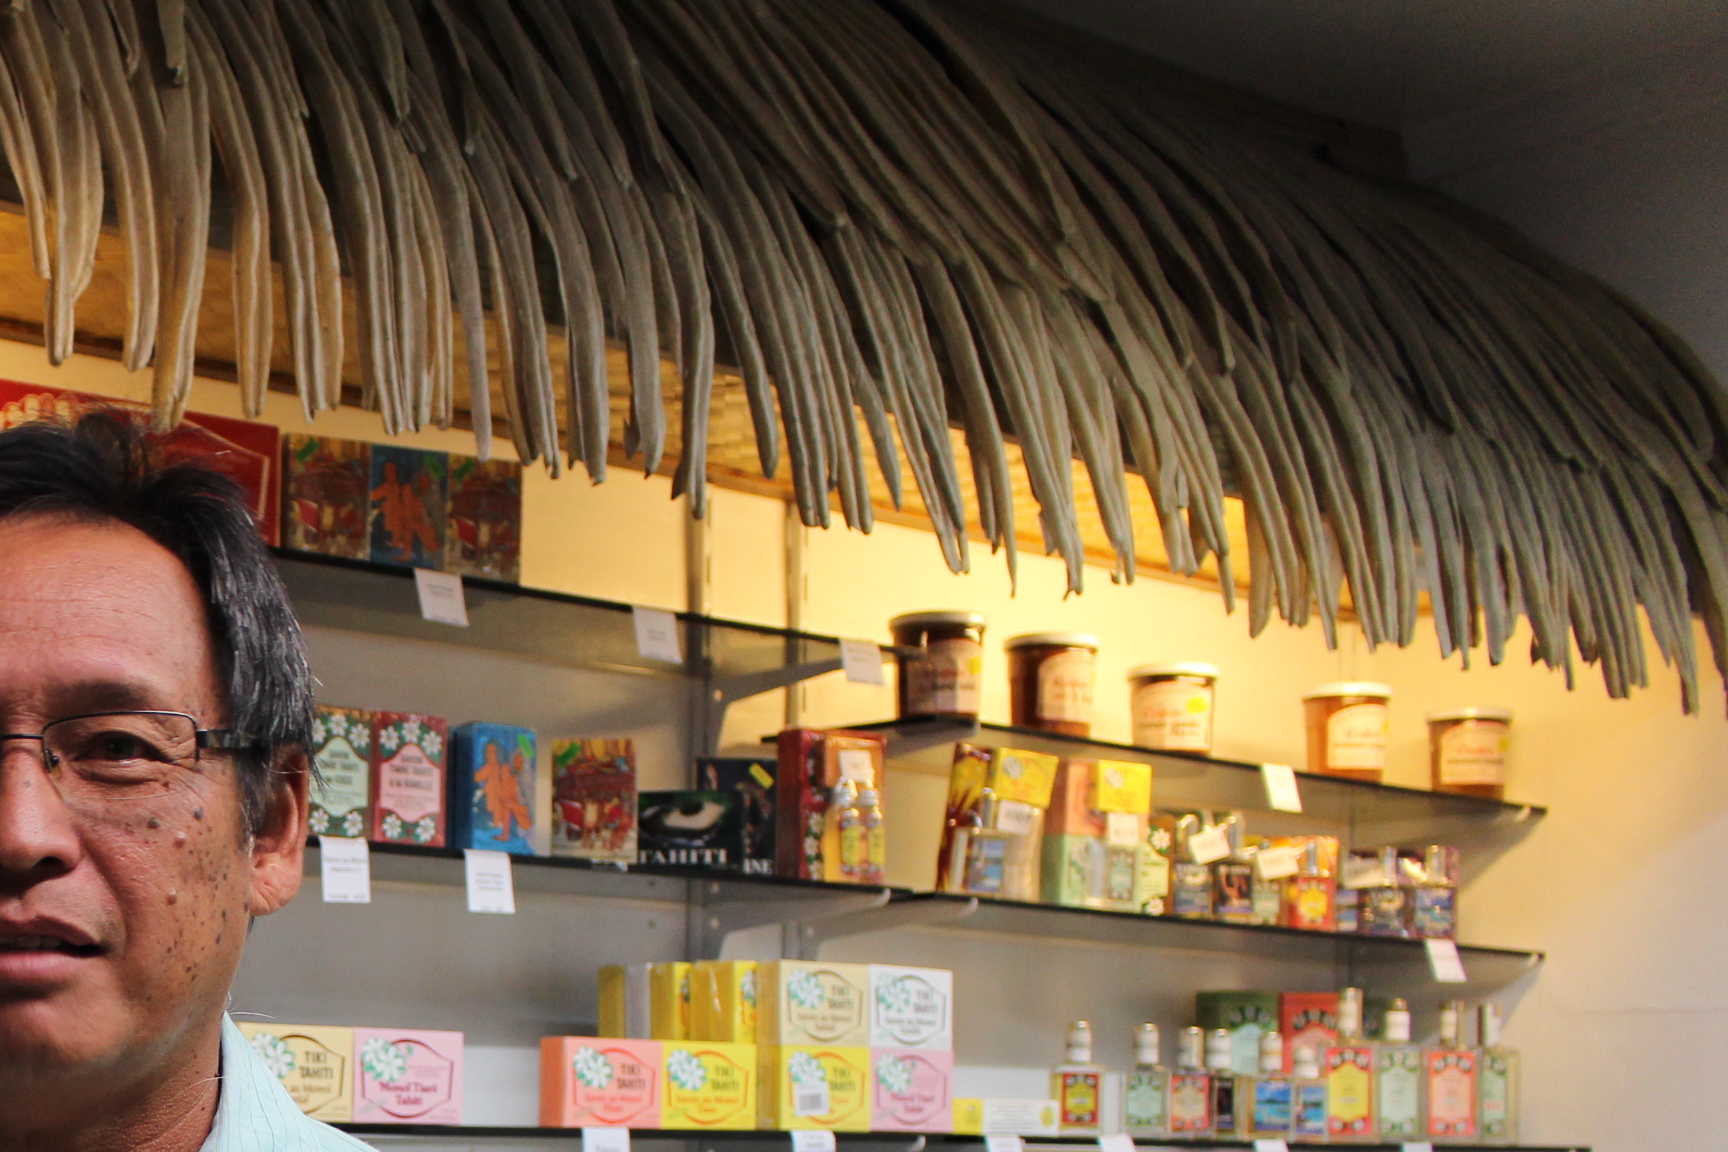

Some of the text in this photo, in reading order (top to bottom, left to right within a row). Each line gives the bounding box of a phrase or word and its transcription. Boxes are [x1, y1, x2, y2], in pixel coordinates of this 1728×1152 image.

[639, 848, 728, 864] TAHITI
[304, 1051, 328, 1062] TIKI
[299, 1066, 334, 1078] TAHITI
[621, 1064, 642, 1074] TIKI
[716, 1066, 735, 1076] TIKI
[617, 1080, 646, 1090] TAHITI
[712, 1080, 740, 1090] TAHITI
